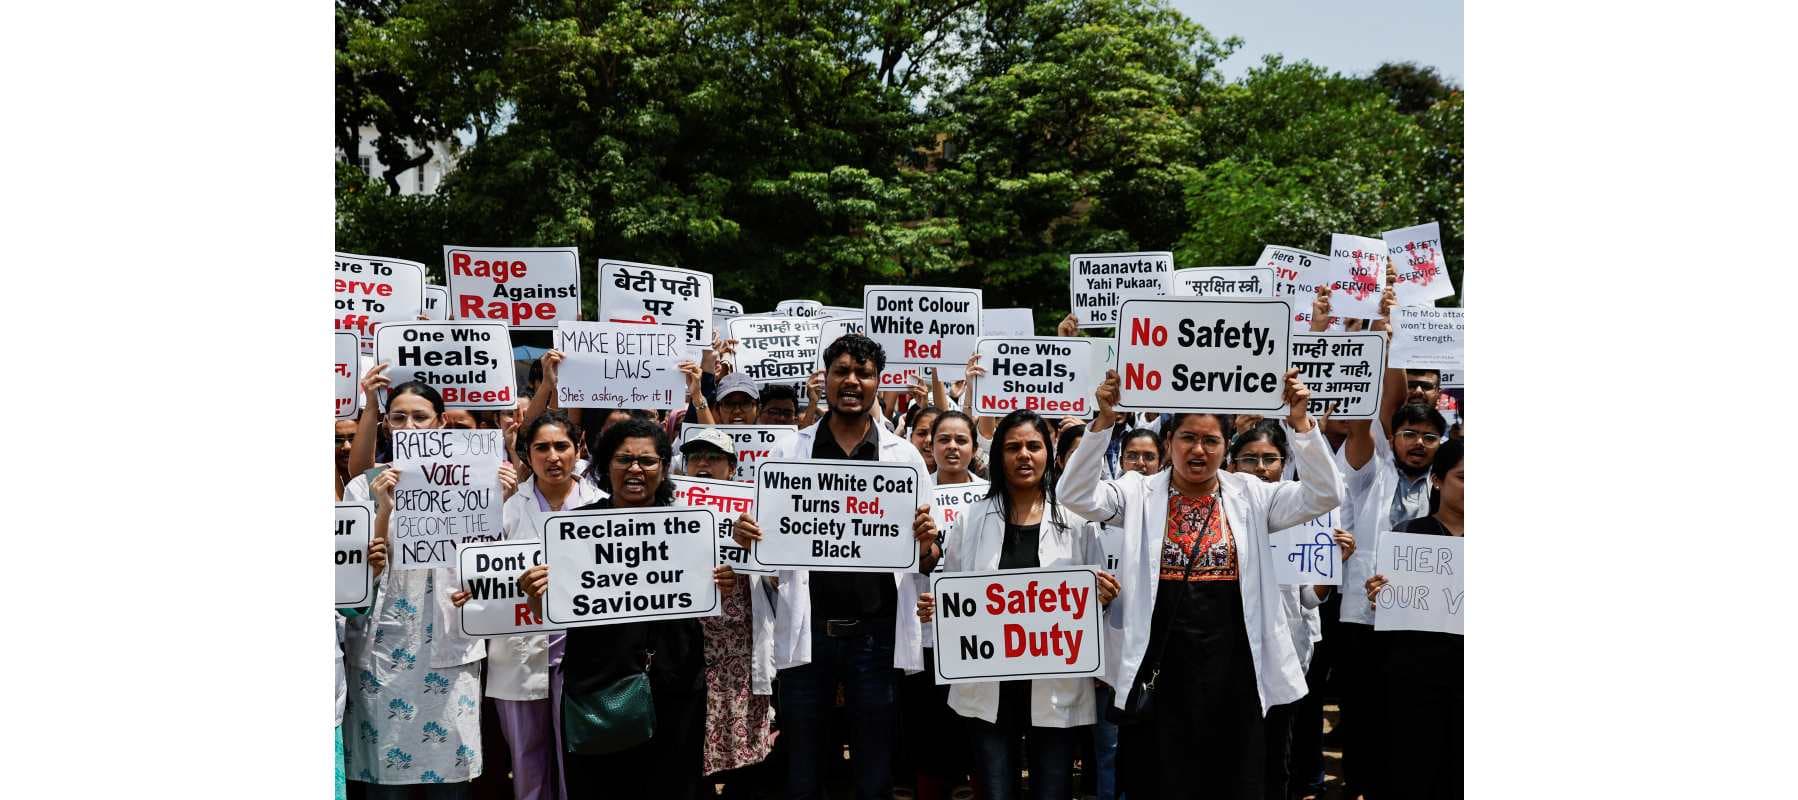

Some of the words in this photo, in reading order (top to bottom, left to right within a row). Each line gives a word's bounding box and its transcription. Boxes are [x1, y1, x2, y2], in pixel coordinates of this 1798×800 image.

[1335, 250, 1349, 258] NO
[1351, 250, 1385, 261] SAFETY
[1389, 246, 1403, 255] NO
[1405, 239, 1439, 251] SAFETY
[452, 253, 528, 284] Rage
[1079, 259, 1152, 275] Maanavta
[1156, 261, 1167, 273] Ki
[1272, 250, 1295, 263] Here
[1299, 255, 1312, 267] To
[1409, 257, 1425, 266] NO
[370, 262, 393, 276] To
[1351, 267, 1368, 276] NO
[1399, 267, 1441, 281] SERVICE
[613, 268, 656, 292] बेटी
[1086, 278, 1112, 290] Yahi
[1116, 277, 1161, 290] Pukaar,
[1299, 283, 1312, 292] NO
[1335, 281, 1380, 292] SERVICE
[493, 284, 577, 301] Against
[1076, 292, 1119, 307] Mahil
[362, 300, 385, 313] To
[460, 295, 557, 325] Rape
[643, 299, 674, 316] पर
[877, 296, 914, 312] Dont
[918, 297, 970, 312] Colour
[1401, 310, 1418, 318] The
[1420, 310, 1440, 318] Mob
[1091, 310, 1107, 322] Ho
[1400, 321, 1426, 330] won't
[1429, 321, 1453, 330] break
[403, 329, 445, 342] One
[451, 329, 491, 342] Who
[871, 316, 924, 335] White
[929, 320, 975, 339] Apron
[1131, 317, 1168, 347] No
[1177, 318, 1275, 356] Safety,
[561, 330, 609, 353] MAKE
[616, 331, 681, 357] BETTER
[904, 339, 942, 359] Red
[997, 343, 1030, 355] One
[1036, 344, 1071, 356] Who
[398, 346, 498, 370] Heals,
[413, 370, 487, 385] Should
[604, 359, 651, 379] LAWS
[992, 358, 1075, 382] Heals,
[1125, 363, 1162, 391] No
[1171, 364, 1278, 393] Service
[1340, 360, 1372, 378] नाही,
[442, 386, 511, 402] Bleed
[559, 387, 585, 402] She's
[591, 387, 629, 407] asking
[630, 388, 648, 402] for
[652, 390, 662, 401] it
[1003, 381, 1064, 394] Should
[1325, 382, 1371, 393] आमचा
[982, 396, 1018, 410] Not
[1025, 397, 1085, 411] Bleed
[396, 431, 453, 459] RAISE
[459, 431, 500, 458] YOUR
[758, 431, 775, 443] To
[421, 462, 471, 486] VOICE
[764, 471, 812, 490] When
[818, 473, 867, 492] White
[873, 475, 913, 493] Coat
[395, 489, 452, 513] BEFORE
[458, 488, 489, 513] YOU
[792, 494, 840, 513] Turns
[846, 496, 884, 518] Red,
[397, 516, 458, 538] BECOME
[464, 513, 490, 534] THE
[560, 519, 656, 541] Reclaim
[664, 517, 701, 534] the
[780, 517, 845, 540] Society
[852, 518, 899, 537] Turns
[403, 539, 451, 564] NEXT
[595, 541, 669, 568] Night
[812, 540, 861, 559] Black
[1288, 532, 1337, 578] नाही
[476, 553, 526, 573] Dont
[1393, 545, 1454, 576] HER
[580, 571, 639, 589] Save
[646, 569, 684, 585] our
[573, 592, 693, 616] Saviours
[942, 592, 977, 618] No
[986, 580, 1089, 620] Safety
[1379, 583, 1430, 611] OUR
[960, 635, 995, 660] No
[1003, 623, 1083, 665] Duty
